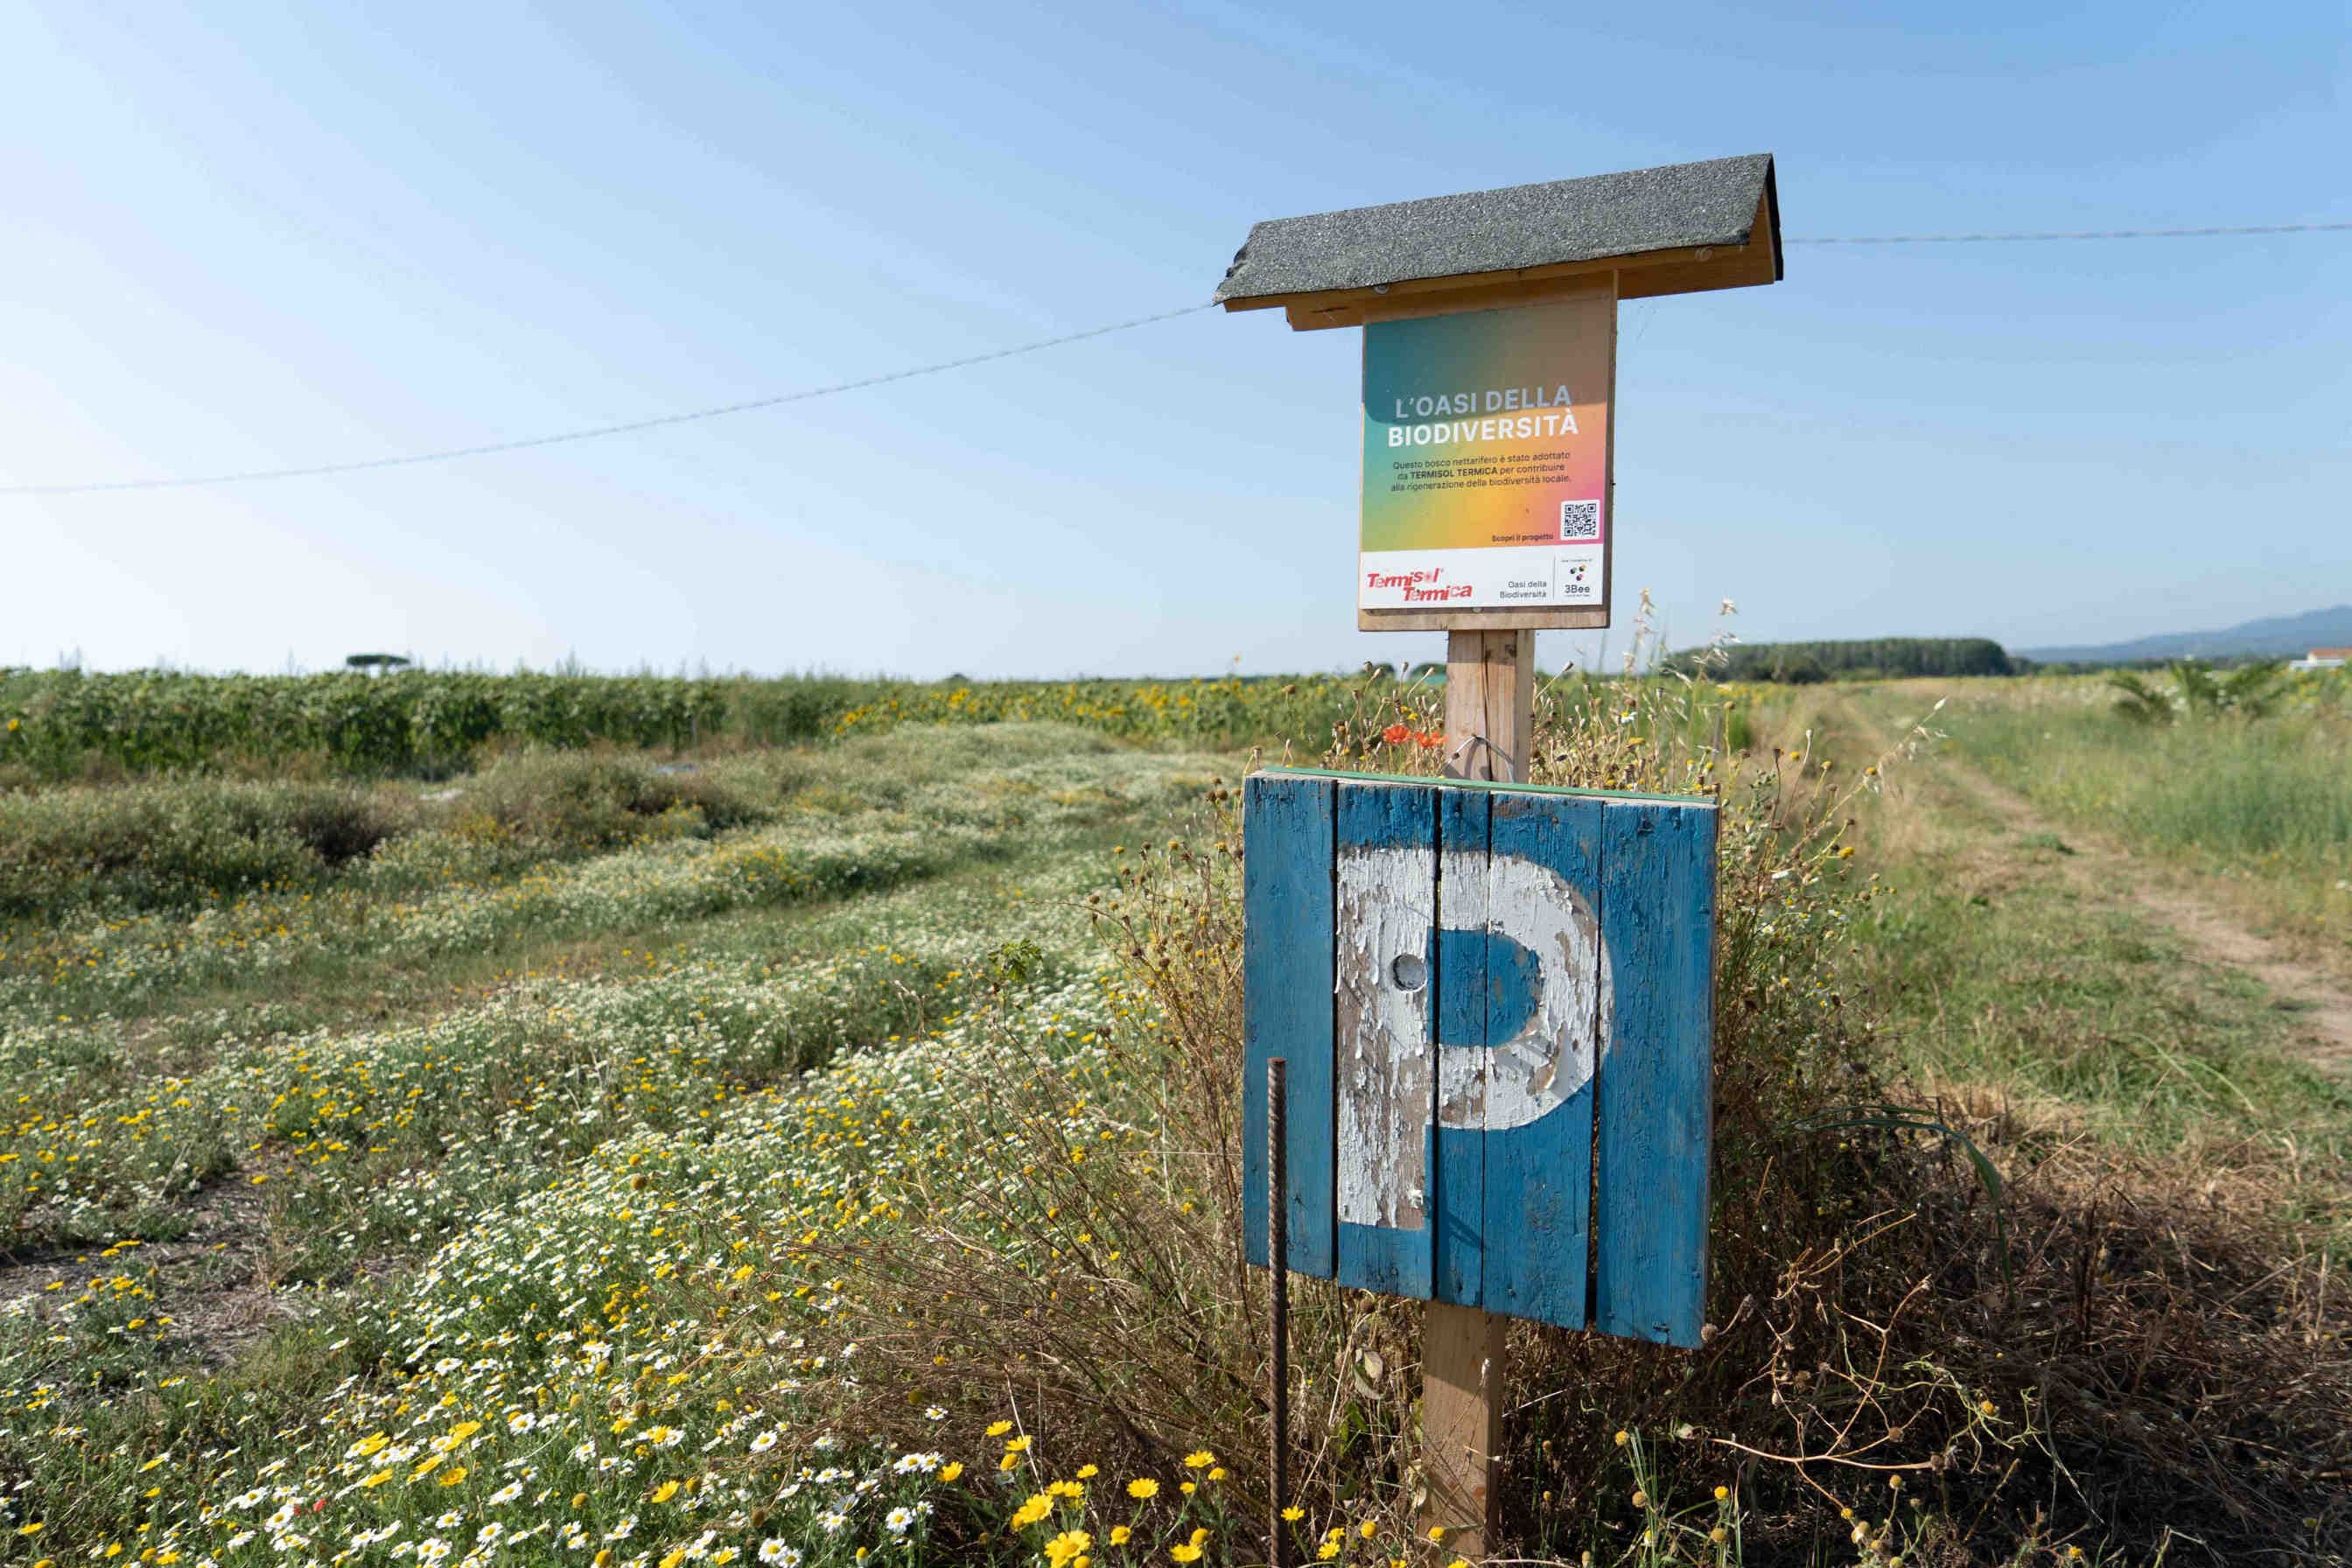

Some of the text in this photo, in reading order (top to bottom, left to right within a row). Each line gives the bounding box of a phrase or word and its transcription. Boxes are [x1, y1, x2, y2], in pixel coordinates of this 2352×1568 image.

[1396, 384, 1572, 418] L'OASI DELLA
[1388, 408, 1579, 447] BIODIVERSITÀ
[1393, 461, 1423, 471] Questo
[1424, 458, 1451, 468] bosco
[1452, 455, 1497, 466] nettarifero
[1507, 453, 1530, 463] stato
[1532, 452, 1571, 461] adottato
[1397, 463, 1565, 480] da TERMISOL TERMICA per contribuire
[1391, 483, 1404, 492] alla
[1407, 480, 1464, 492] rigenerazione
[1466, 479, 1488, 487] della
[1489, 475, 1541, 486] biodiversità
[1492, 534, 1515, 542] Scopri
[1522, 533, 1554, 542] progetto
[1528, 579, 1547, 588] della
[1564, 584, 1591, 593] 3Bee
[1335, 847, 1615, 1230] P
